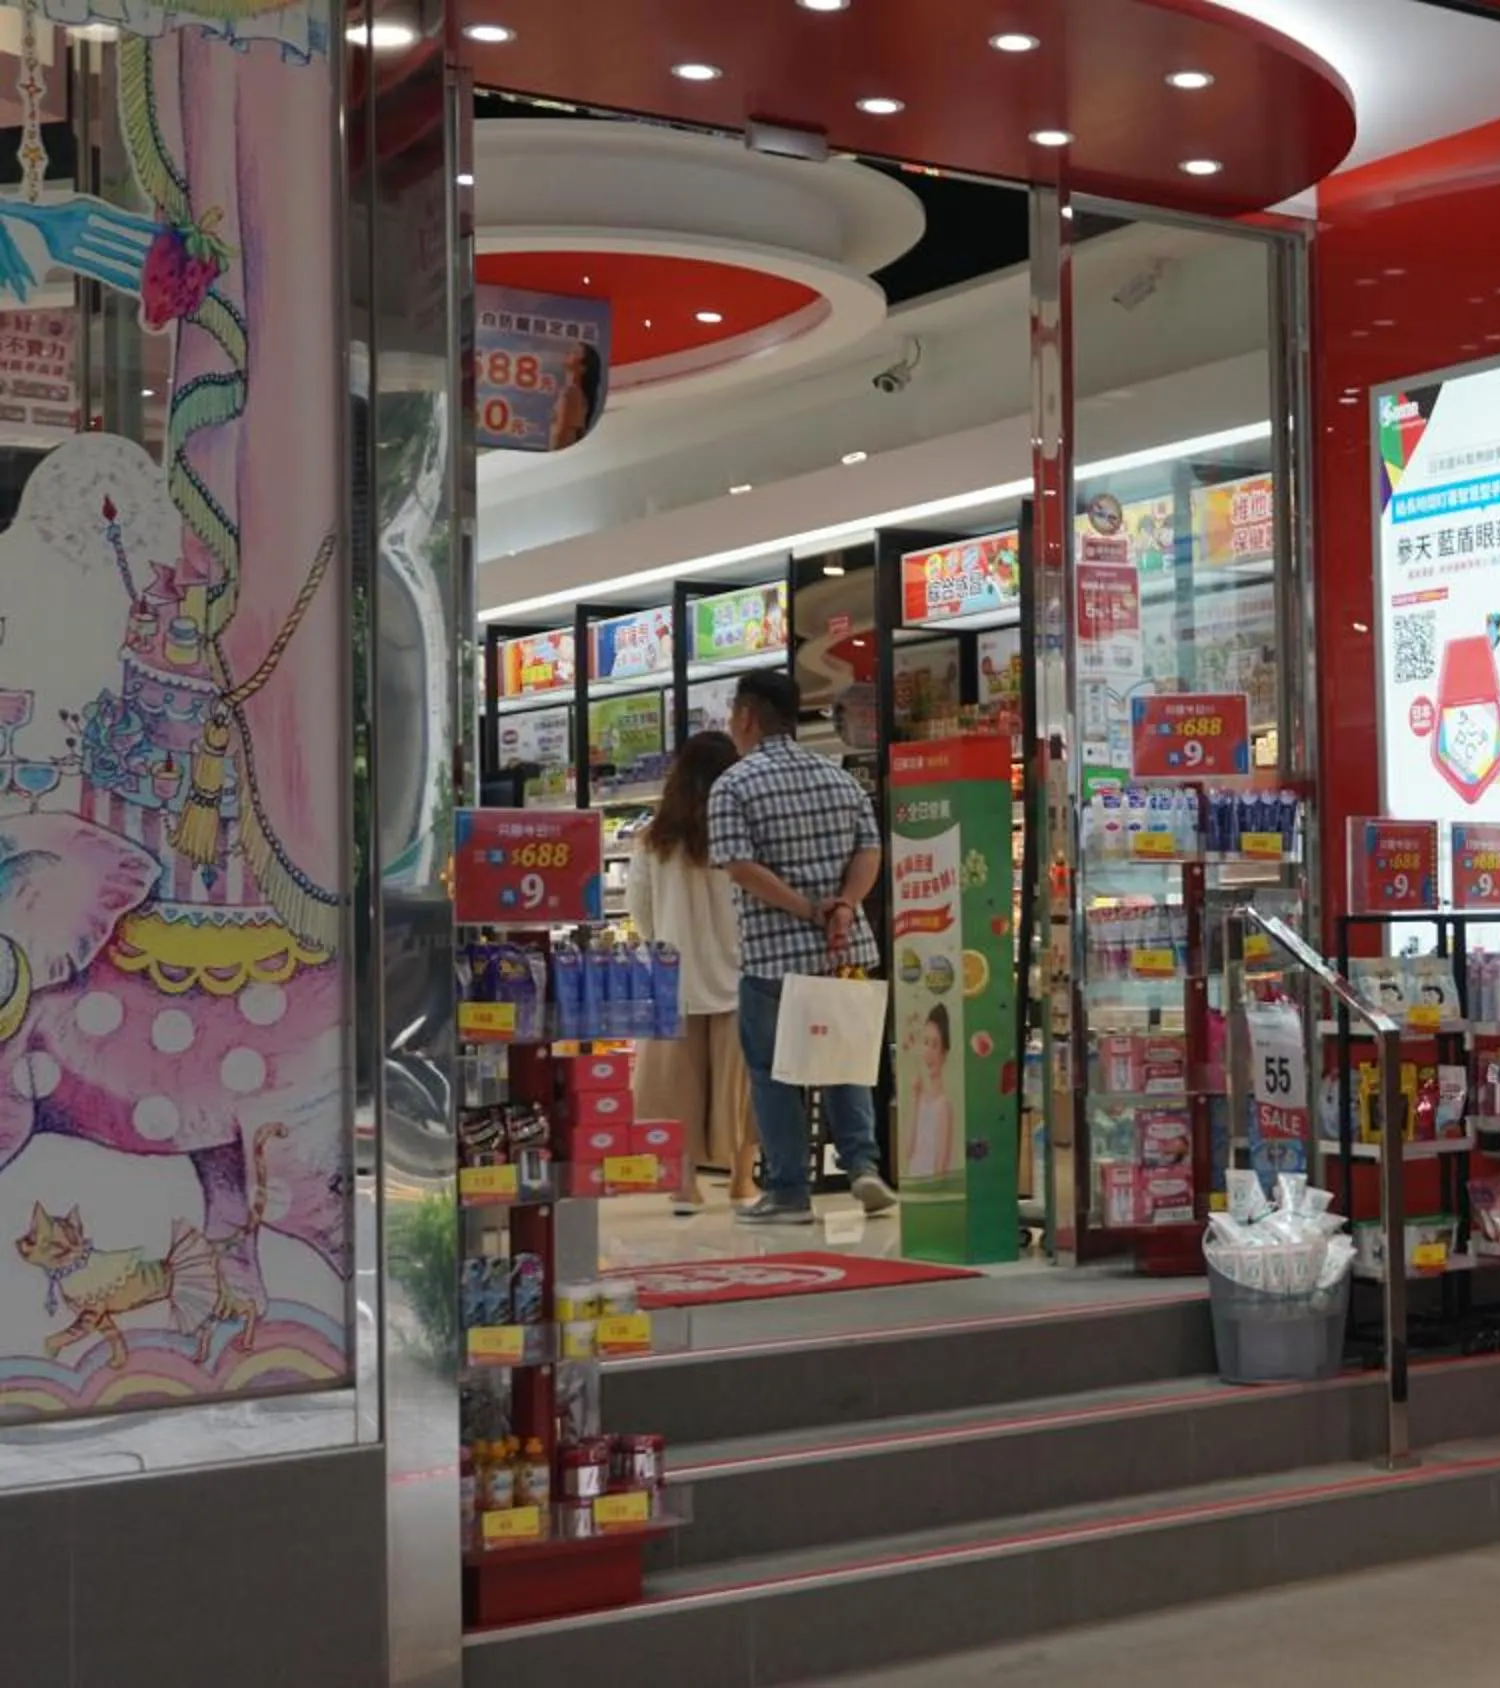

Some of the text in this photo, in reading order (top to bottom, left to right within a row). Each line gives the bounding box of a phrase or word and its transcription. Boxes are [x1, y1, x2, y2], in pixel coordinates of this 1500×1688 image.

[1232, 490, 1273, 526] 維他
[1232, 521, 1273, 553] 保健
[1183, 740, 1204, 766] 9
[511, 843, 570, 867] $688
[521, 873, 545, 908] 9
[1394, 873, 1408, 898] 9
[1478, 873, 1494, 897] 9
[1264, 1057, 1291, 1094] 55
[1260, 1104, 1302, 1137] SALE
